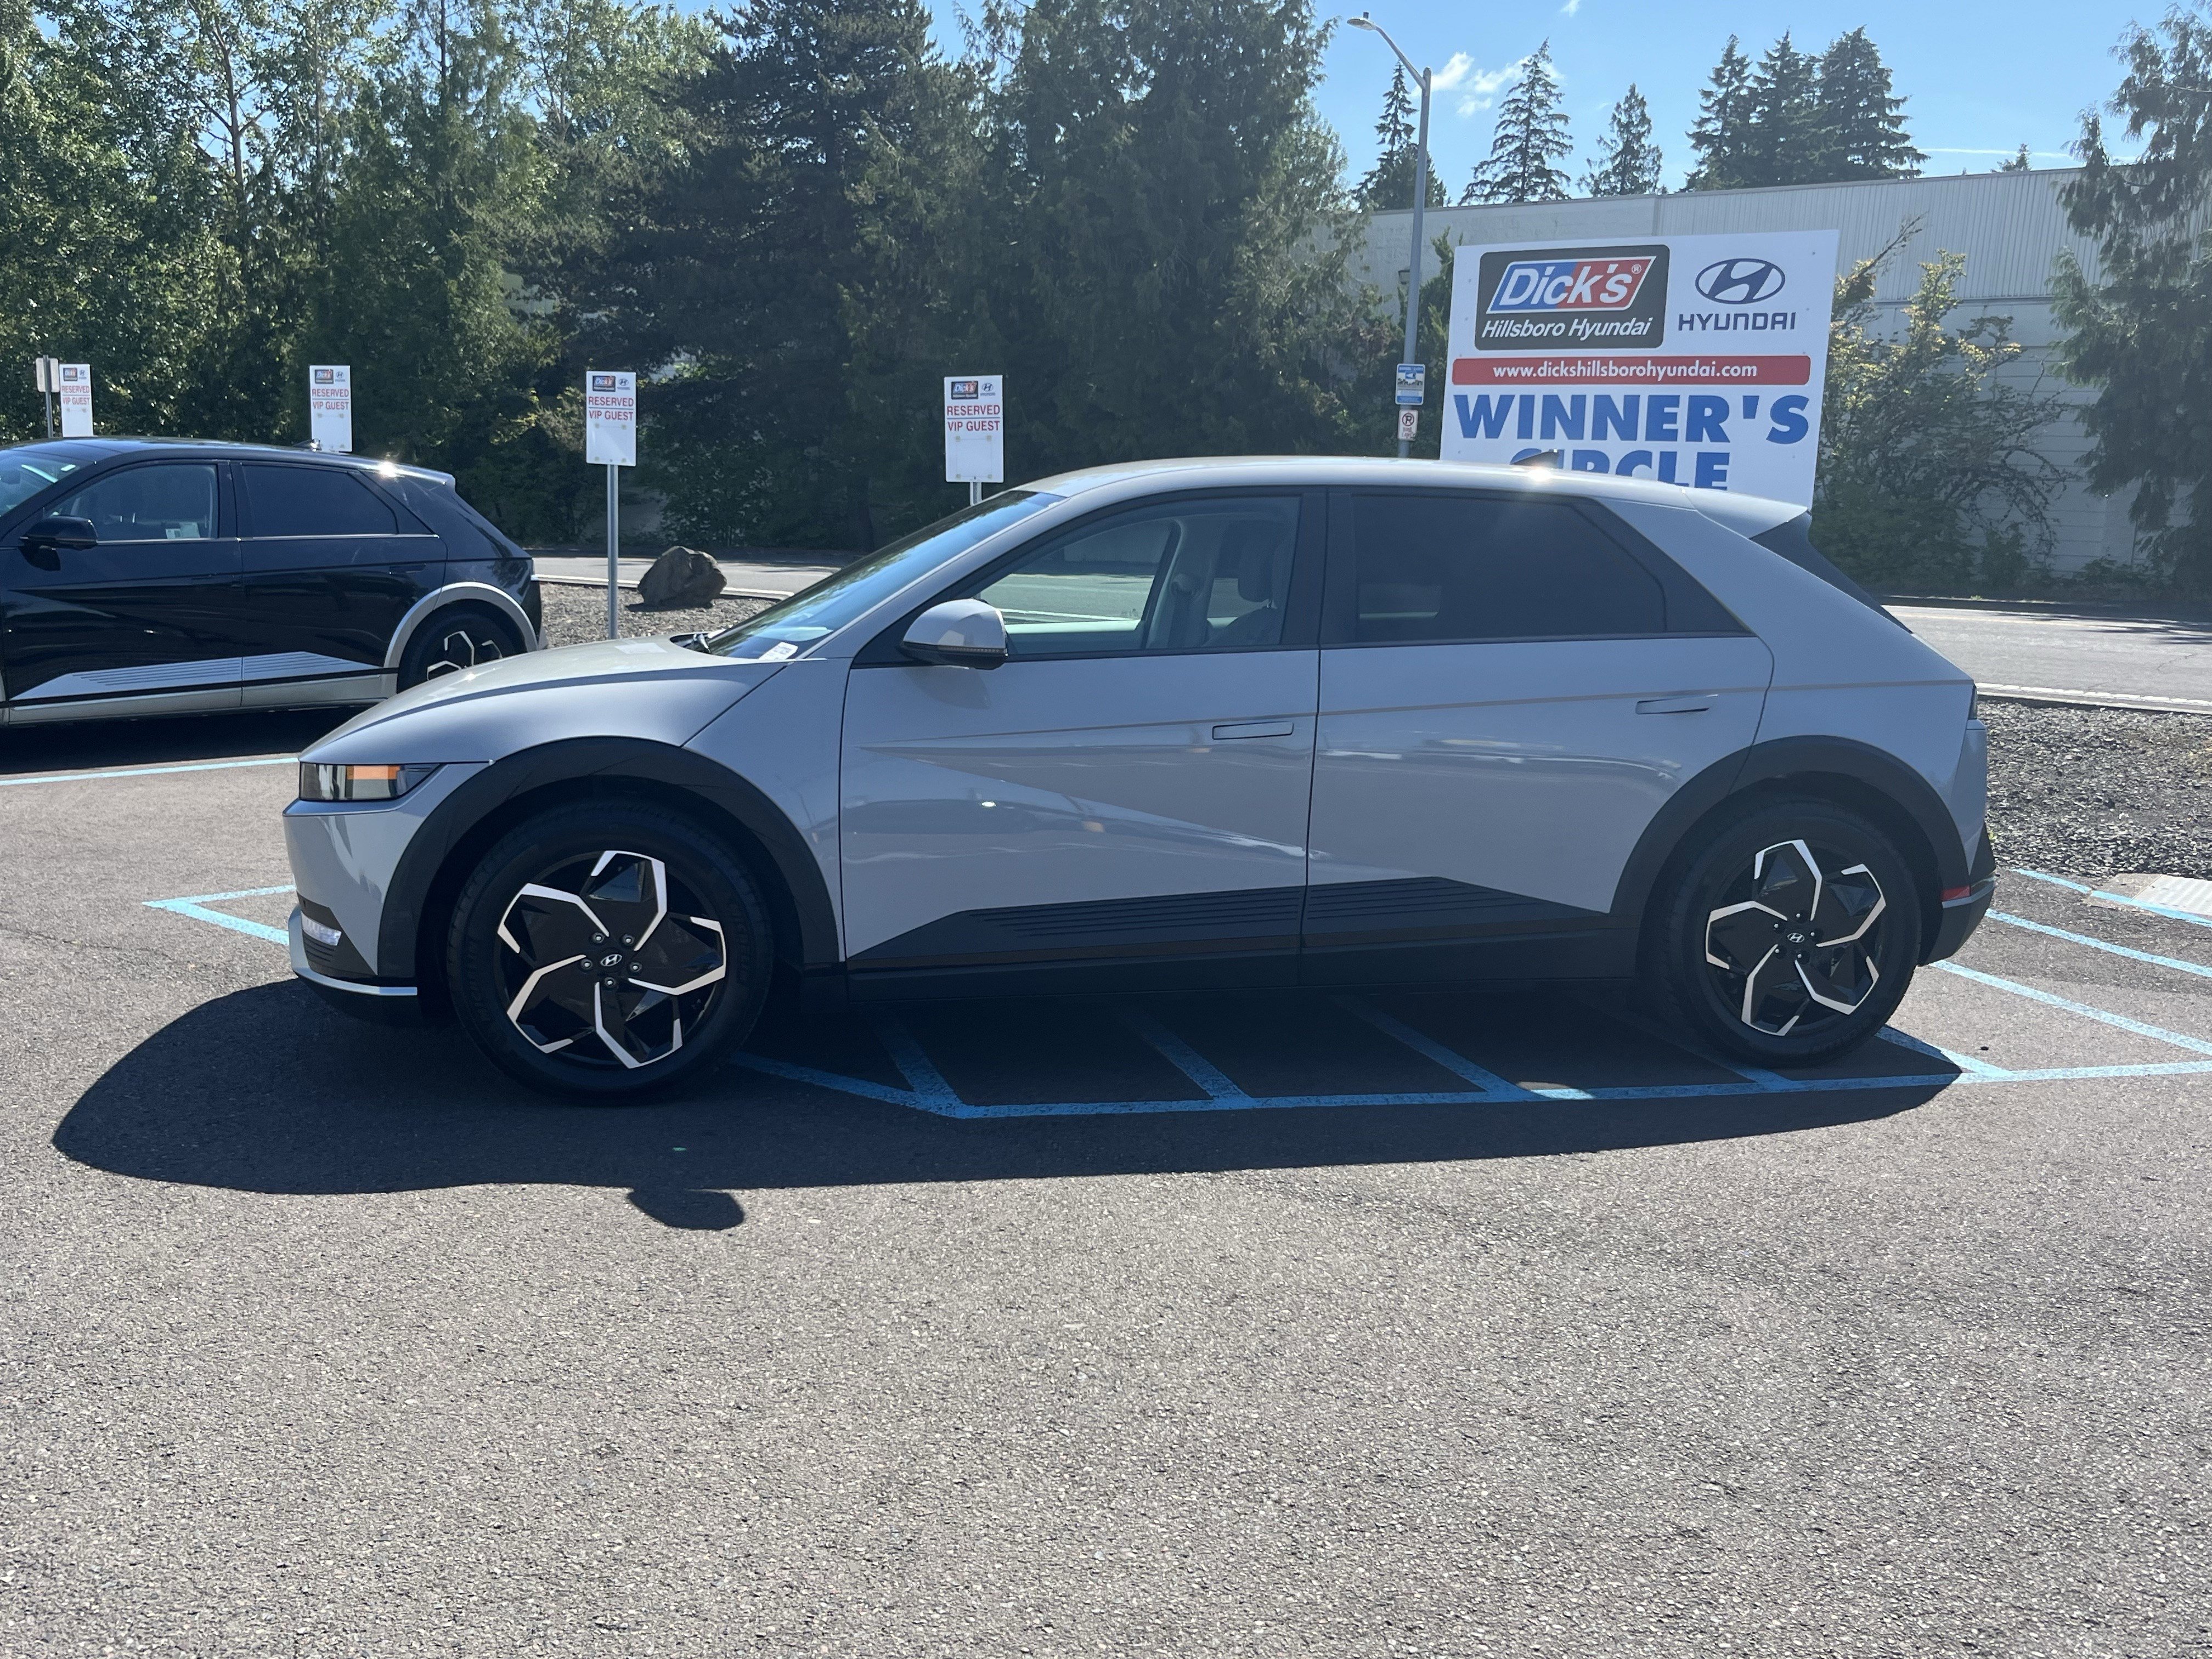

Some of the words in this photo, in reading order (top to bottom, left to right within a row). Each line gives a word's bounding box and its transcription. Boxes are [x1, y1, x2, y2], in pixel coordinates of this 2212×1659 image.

[1499, 264, 1633, 306] Dick's
[1678, 312, 1796, 331] HYUNDAI
[1481, 319, 1566, 338] Hillsboro
[1568, 317, 1654, 341] Hyundai
[1493, 359, 1757, 382] www.dickshillsborohyundai.com
[61, 385, 90, 393] RESERVED
[312, 388, 349, 397] RESERVED
[72, 397, 91, 405] GUEST
[312, 401, 324, 410] VIP
[325, 401, 349, 410] GUEST
[588, 396, 634, 407] RESERVED
[589, 410, 602, 420] VIP
[605, 411, 634, 421] GUEST
[946, 404, 1001, 416] RESERVED
[1453, 394, 1810, 445] WINNER'S
[947, 421, 963, 432] VIP
[966, 420, 1001, 432] GUEST
